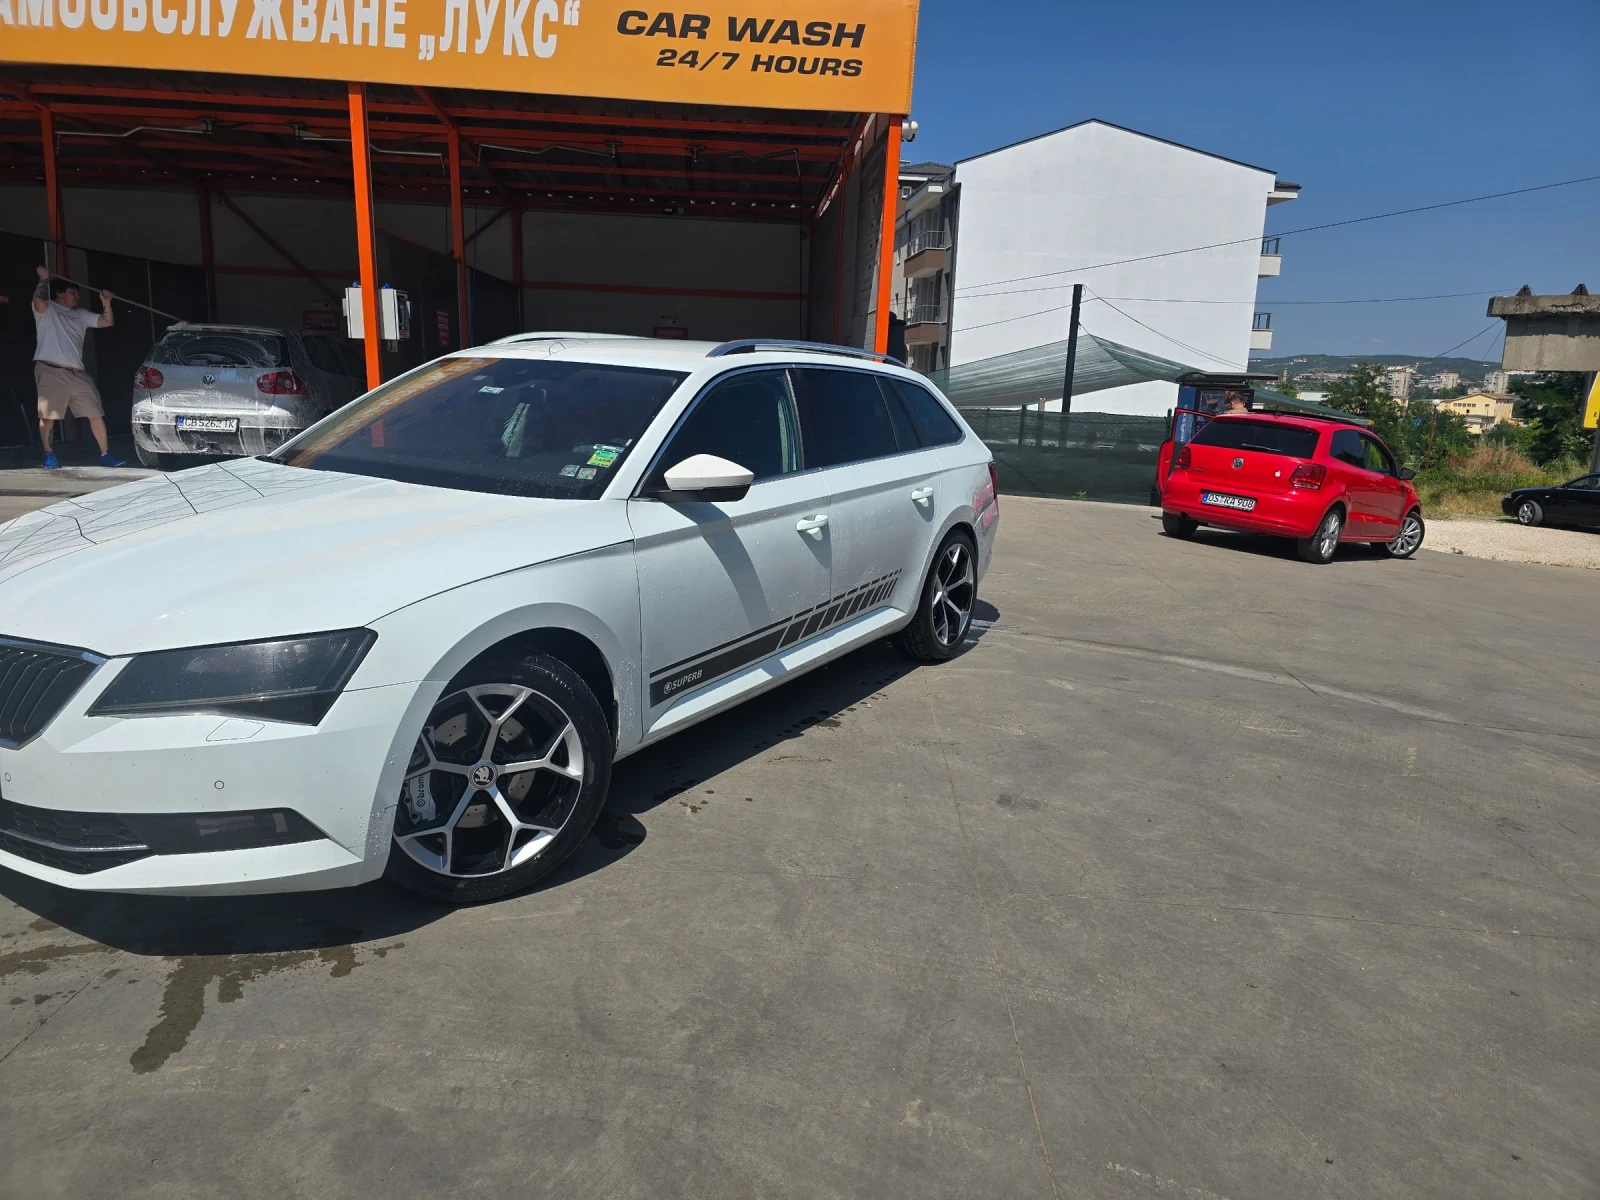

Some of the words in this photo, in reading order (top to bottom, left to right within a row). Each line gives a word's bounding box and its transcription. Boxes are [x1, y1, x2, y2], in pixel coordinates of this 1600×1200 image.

[0, 0, 407, 48] МООБСЛУЖВАНЕ
[616, 10, 711, 40] CAR
[727, 16, 866, 48] WASH
[656, 48, 740, 71] 24/7
[750, 54, 863, 77] HOURS
[1208, 493, 1219, 503] OS
[1237, 499, 1254, 509] 908
[671, 669, 703, 690] SUPERB
